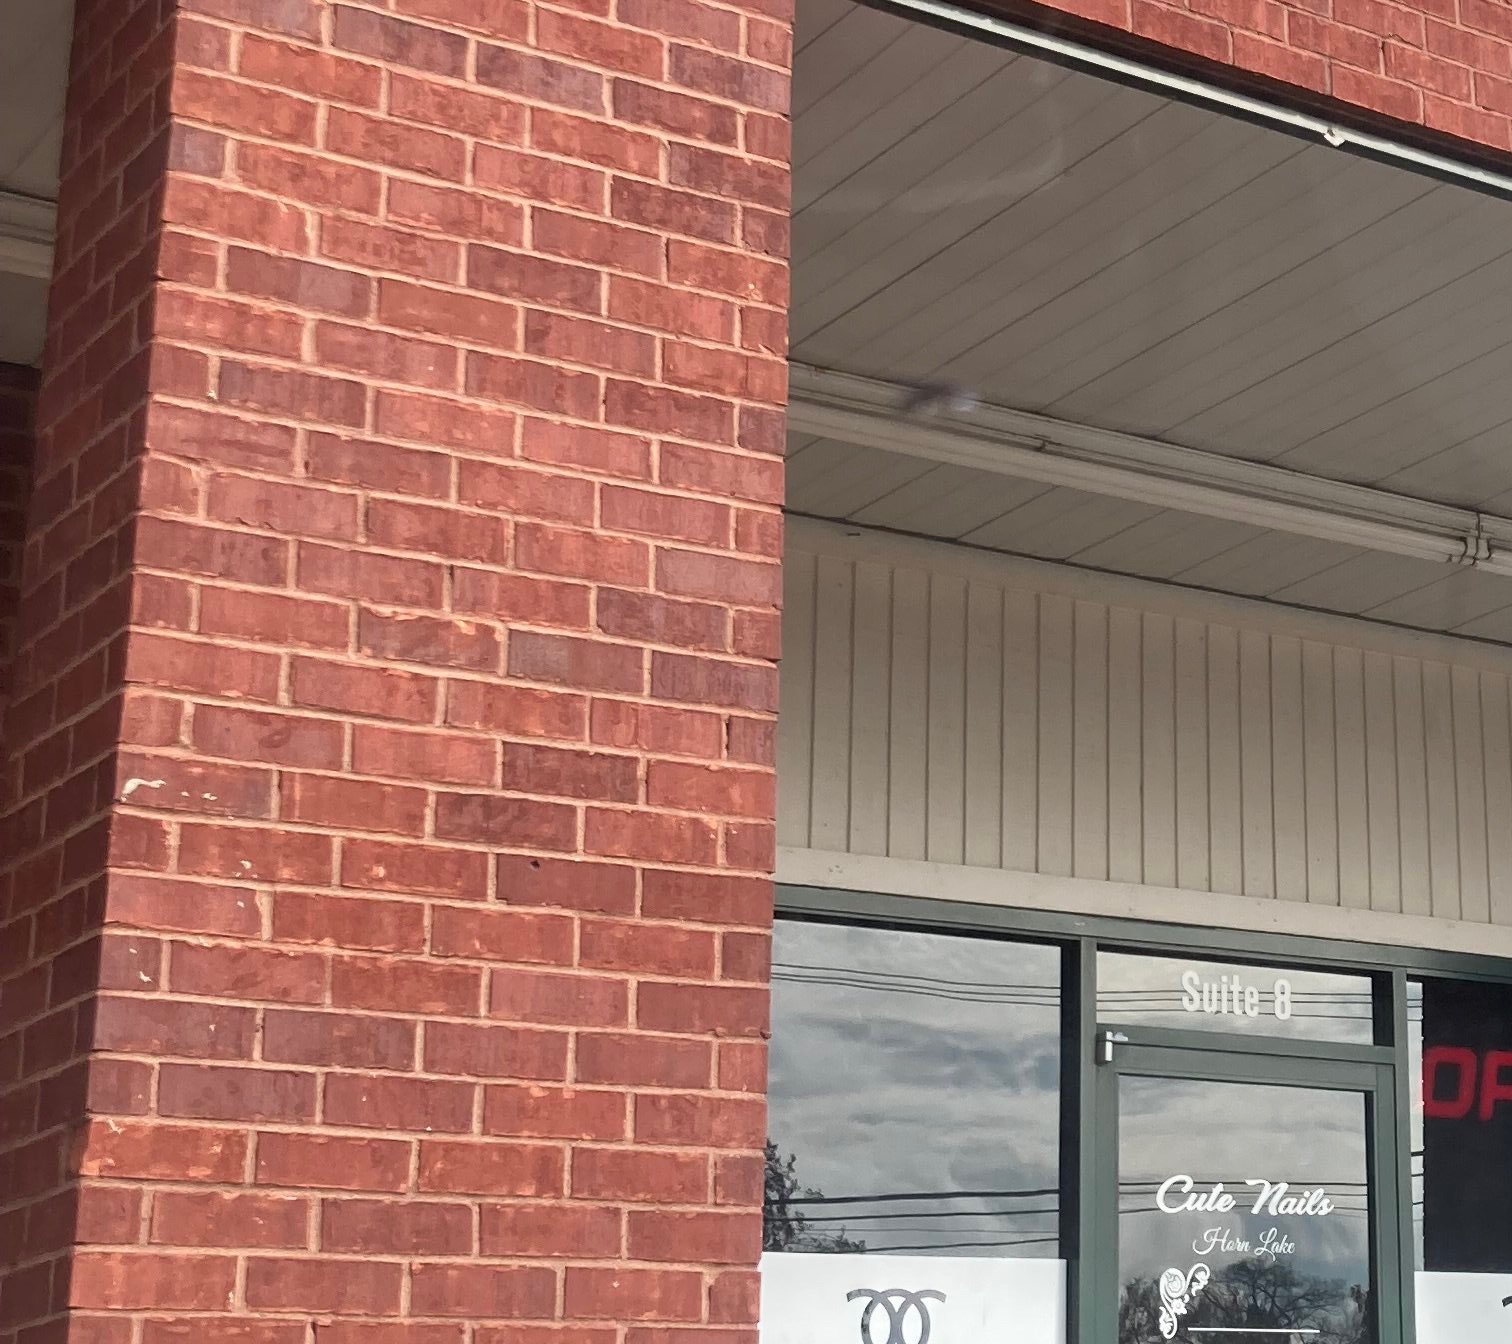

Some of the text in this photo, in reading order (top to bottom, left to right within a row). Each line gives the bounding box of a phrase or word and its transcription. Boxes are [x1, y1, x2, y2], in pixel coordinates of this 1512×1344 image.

[1181, 970, 1292, 1020] Suite 8
[1155, 1174, 1335, 1216] Cute Nails
[1192, 1226, 1296, 1262] Horn Lake
